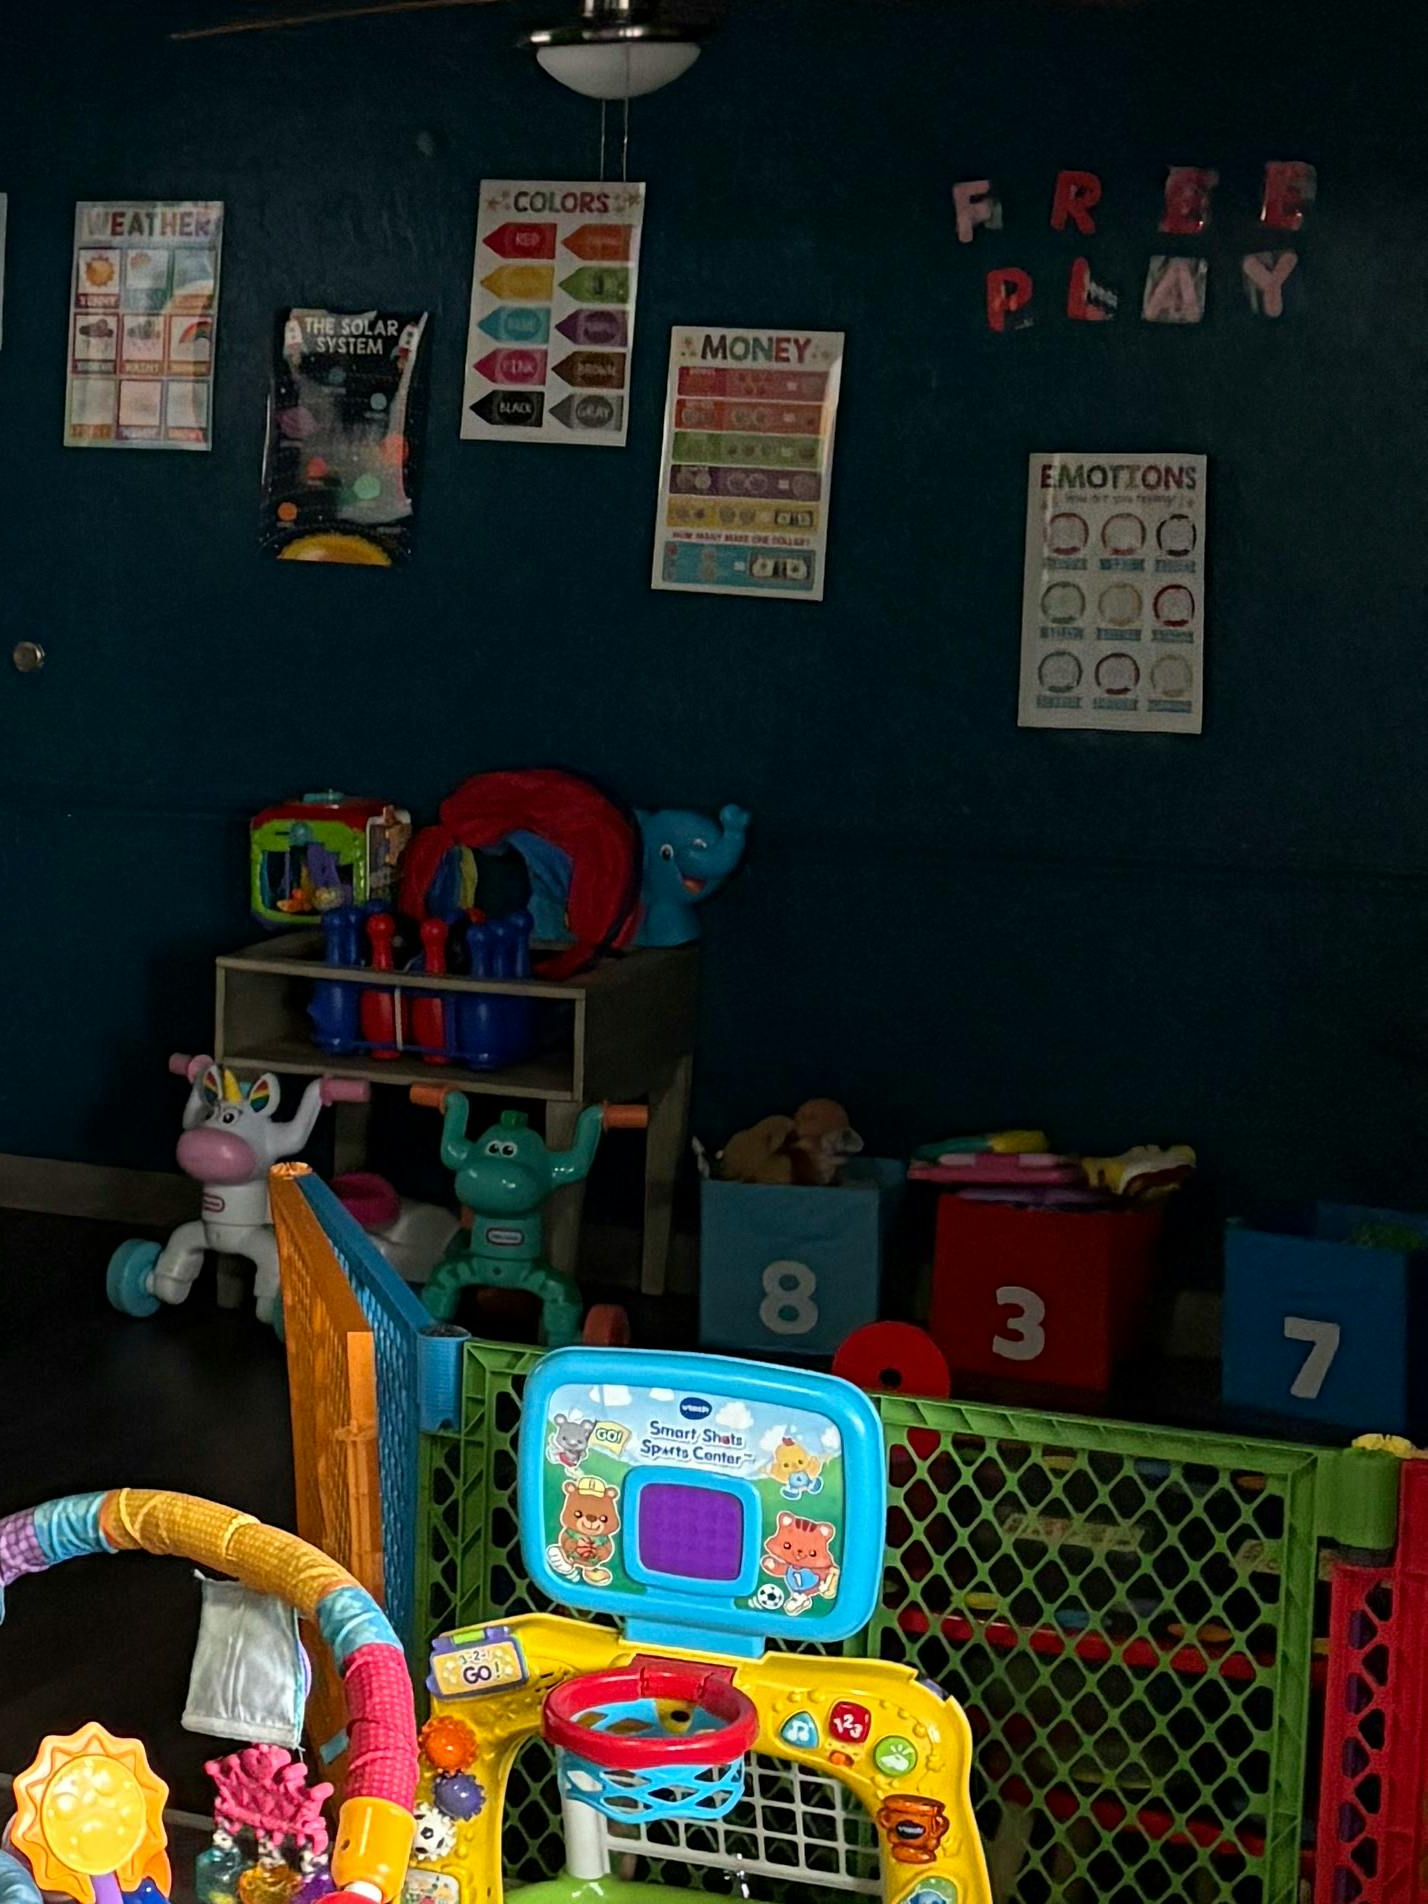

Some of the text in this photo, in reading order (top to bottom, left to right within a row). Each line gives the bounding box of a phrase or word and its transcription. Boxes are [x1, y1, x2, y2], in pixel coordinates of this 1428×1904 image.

[514, 191, 610, 213] COLORS
[86, 208, 214, 238] WEATHER
[305, 317, 399, 336] THE SOLAR
[316, 337, 383, 355] SYSTEM
[701, 334, 812, 364] MONEY
[498, 401, 532, 414] BLACK
[1040, 464, 1195, 489] EMOTIONS
[759, 1260, 819, 1335] 8
[992, 1286, 1046, 1361] 3
[1282, 1316, 1340, 1398] 7
[596, 1427, 622, 1443] GO!
[649, 1420, 743, 1447] Smart Shots
[462, 1660, 502, 1685] GO!
